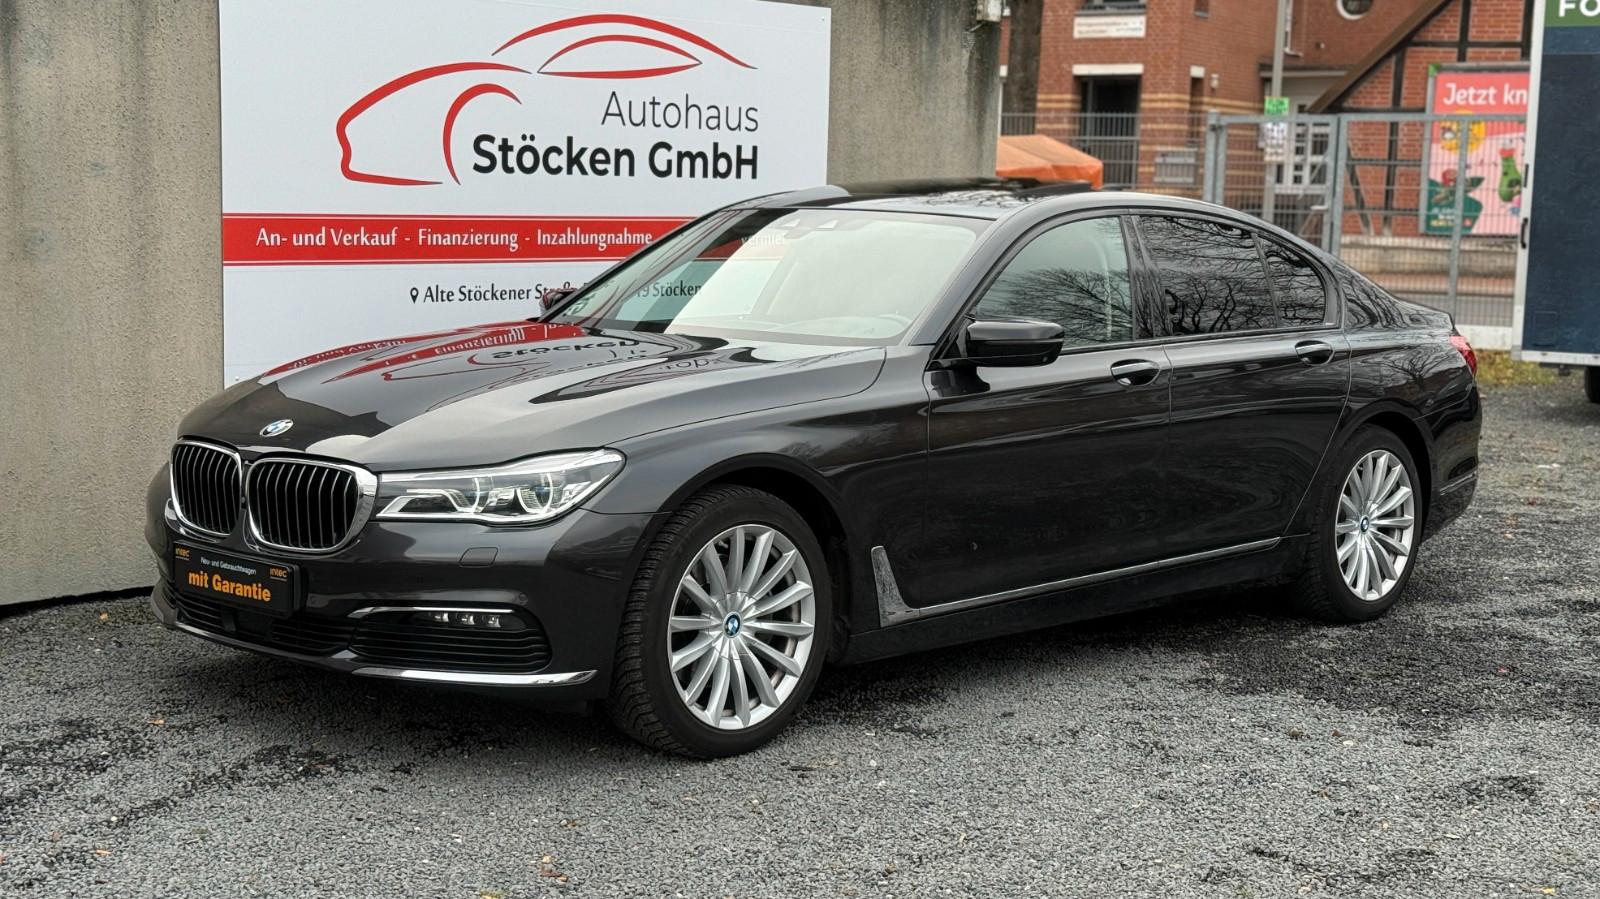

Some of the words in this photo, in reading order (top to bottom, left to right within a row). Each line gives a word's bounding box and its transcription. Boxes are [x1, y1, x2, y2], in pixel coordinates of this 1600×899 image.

[1444, 83, 1497, 105] Jetzt
[601, 90, 759, 132] Autohaus
[472, 133, 635, 176] Stöcken
[648, 141, 758, 180] GmbH
[256, 228, 288, 246] An-
[293, 226, 326, 246] und
[330, 226, 398, 246] Verkauf
[418, 228, 518, 252] Finanzierung
[537, 228, 652, 251] Inzahlungnahme
[424, 284, 454, 302] Alte
[458, 283, 532, 302] Stöckener
[188, 570, 208, 588] mit
[212, 574, 272, 602] Garantie
